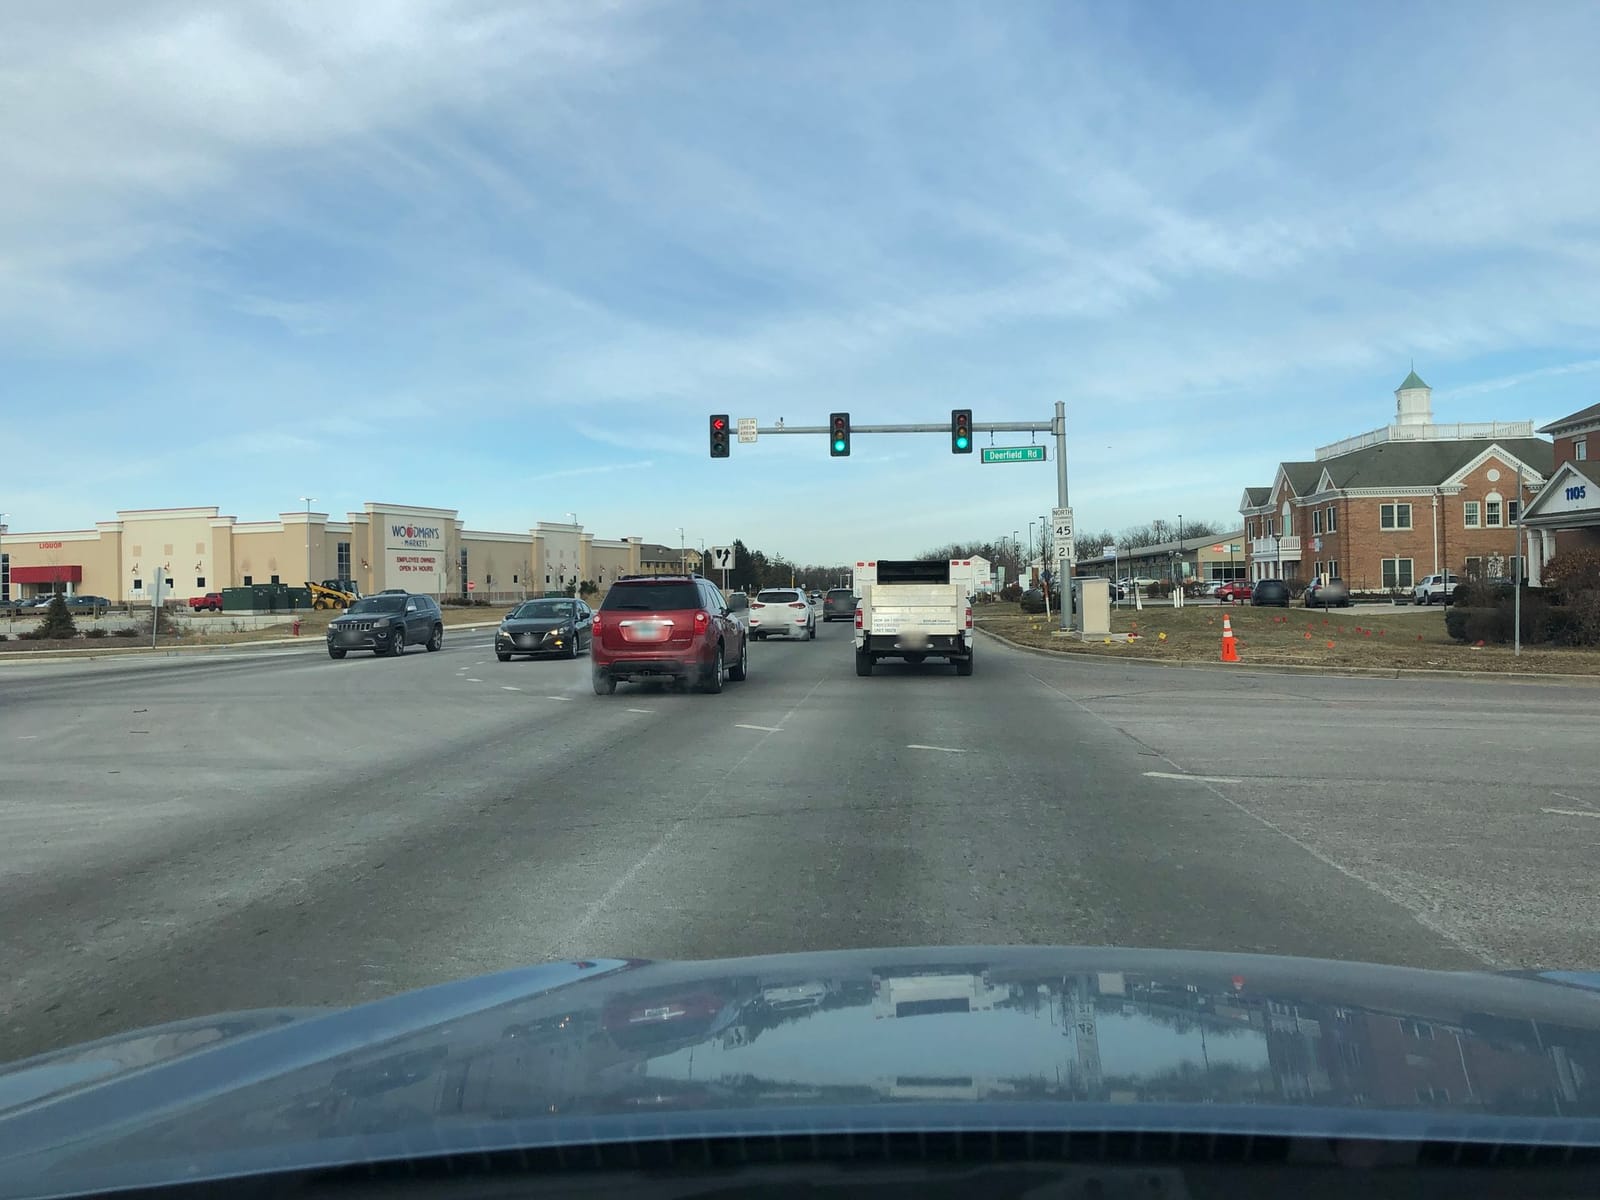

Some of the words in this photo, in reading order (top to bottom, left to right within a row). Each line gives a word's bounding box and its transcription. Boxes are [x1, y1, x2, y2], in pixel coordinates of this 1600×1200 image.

[989, 449, 1022, 460] Deerfield
[1027, 449, 1037, 458] Rd
[1565, 485, 1586, 501] 1105
[391, 526, 440, 539] WOODMAN'S
[1056, 525, 1071, 535] 45
[404, 540, 428, 548] MARKETS
[1058, 546, 1070, 557] 21
